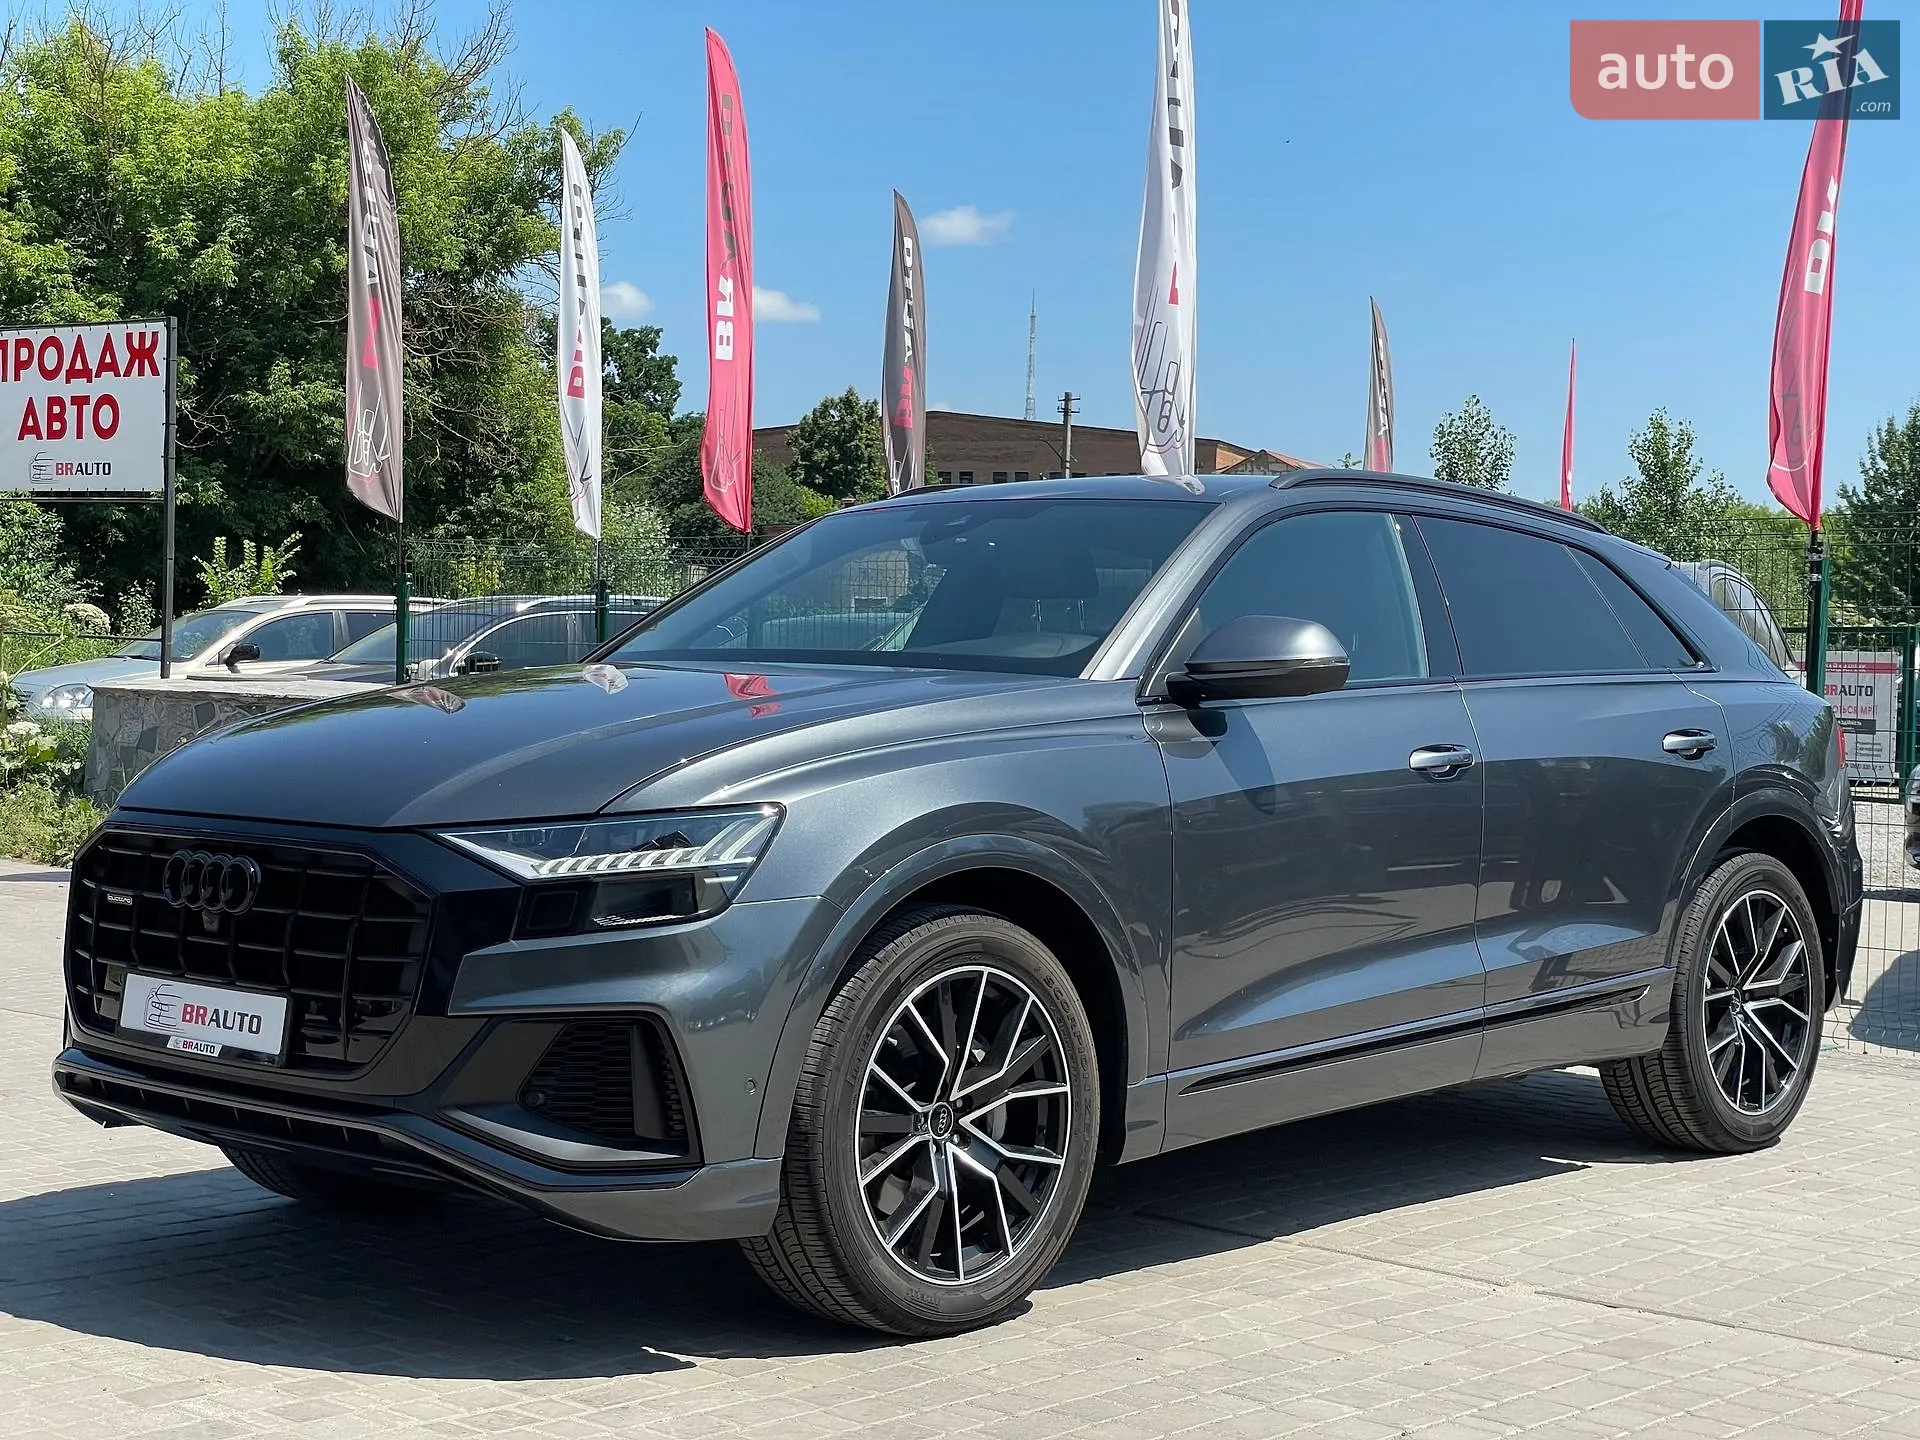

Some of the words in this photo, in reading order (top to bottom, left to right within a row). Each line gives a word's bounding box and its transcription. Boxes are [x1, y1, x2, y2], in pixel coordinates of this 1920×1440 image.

[17, 393, 120, 440] АВТО
[55, 462, 111, 476] BRAUTO
[181, 1002, 262, 1035] BRAUTO
[182, 1040, 216, 1055] BRAUTO
